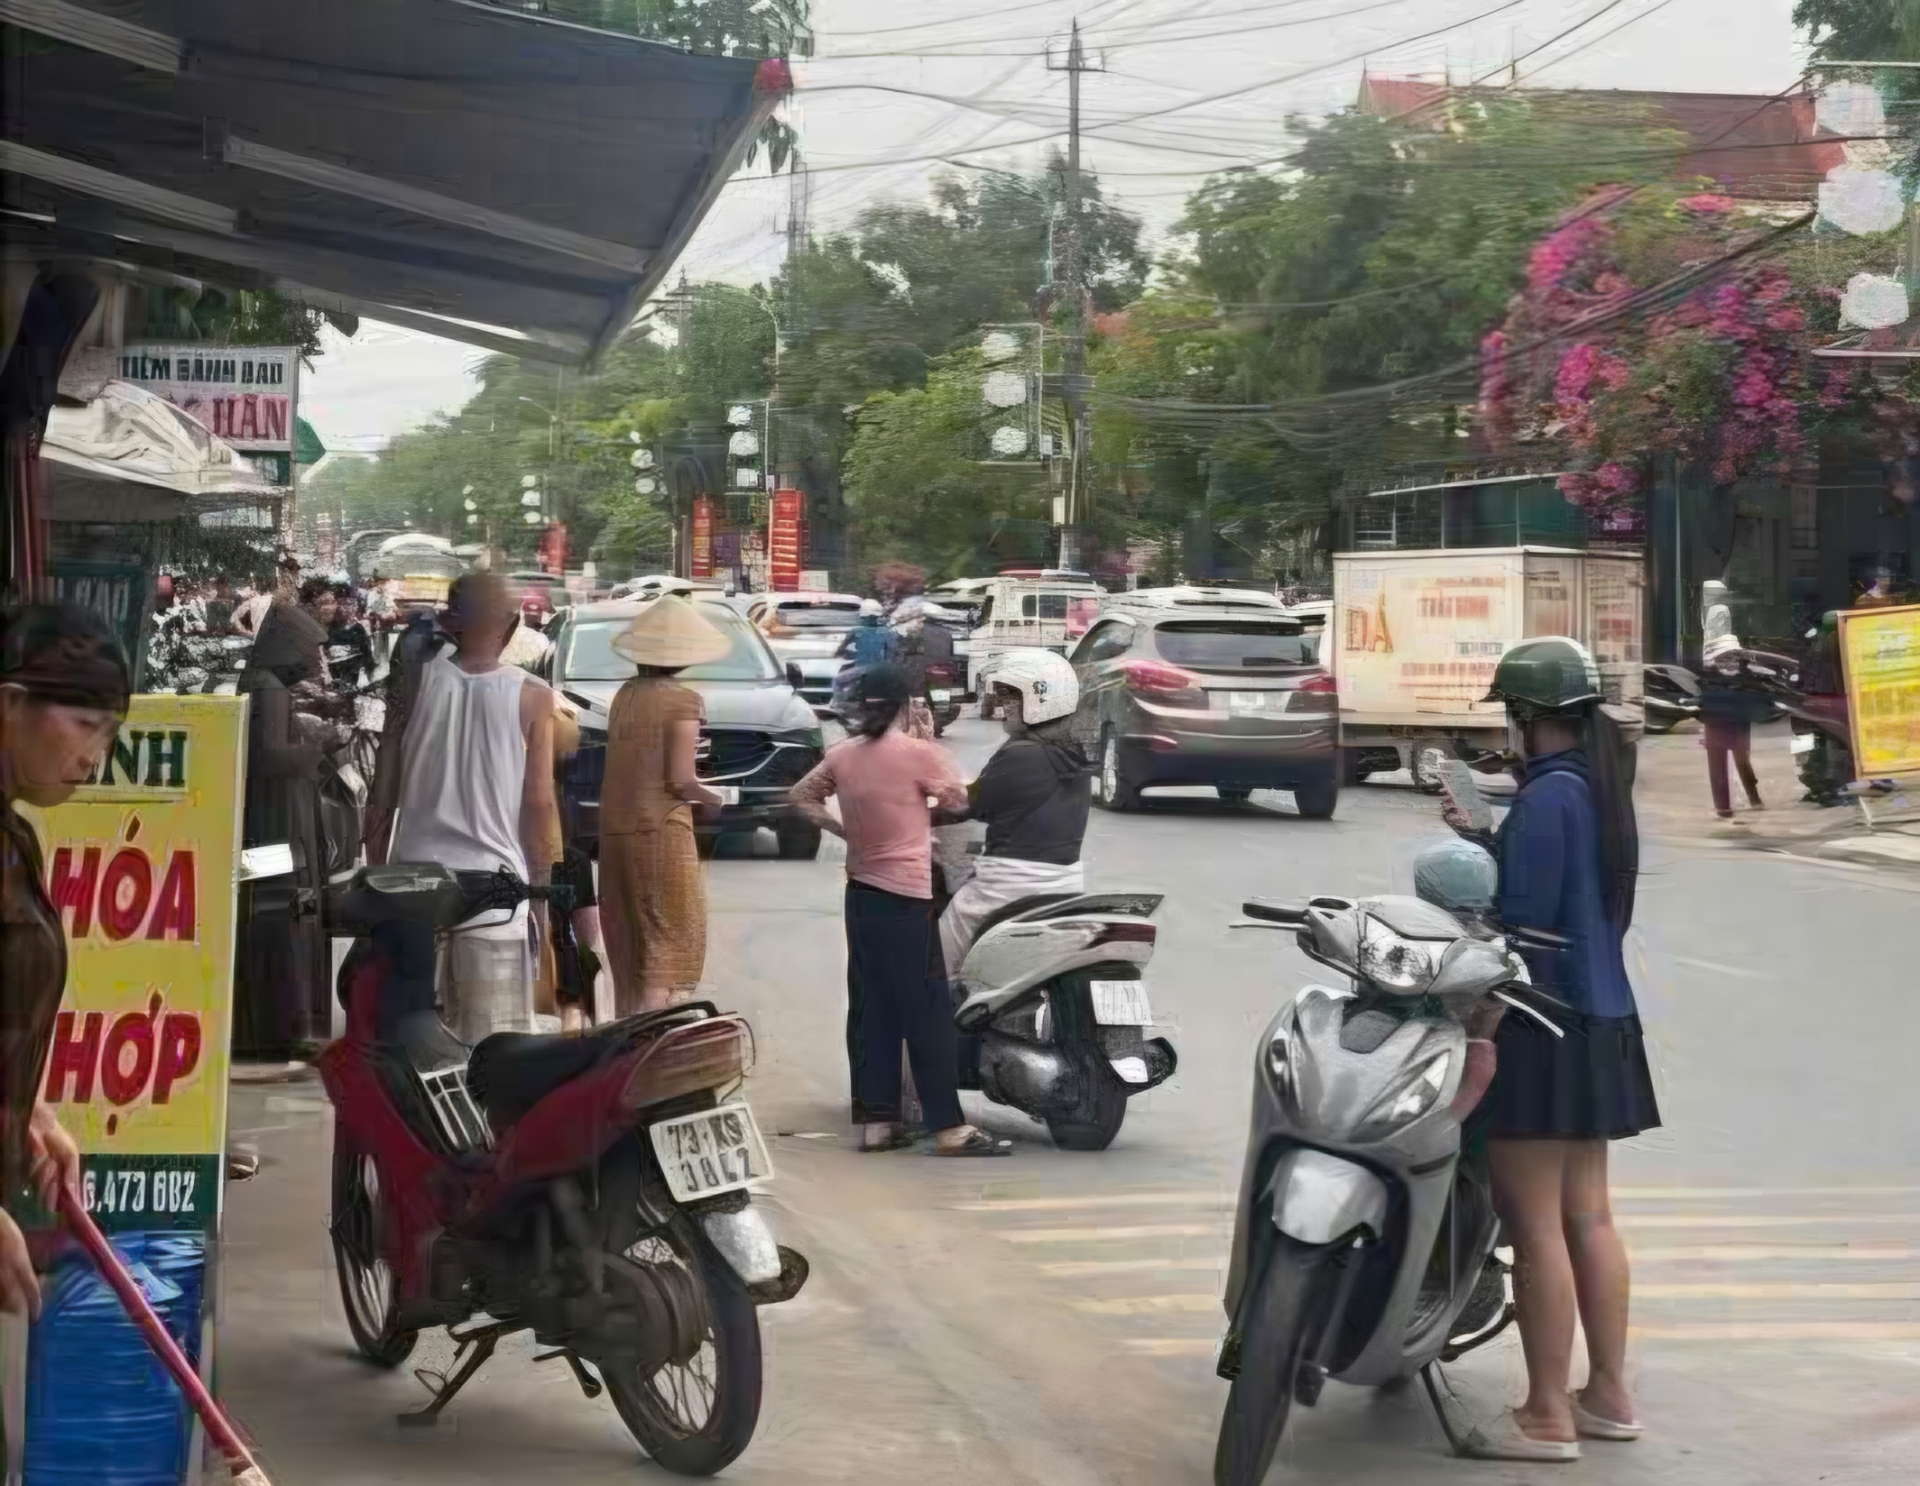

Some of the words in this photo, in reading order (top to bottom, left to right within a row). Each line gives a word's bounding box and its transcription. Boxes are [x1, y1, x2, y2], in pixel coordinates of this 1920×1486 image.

[88, 730, 187, 787] NH
[51, 814, 195, 941] HÓA
[45, 992, 202, 1136] HỢP
